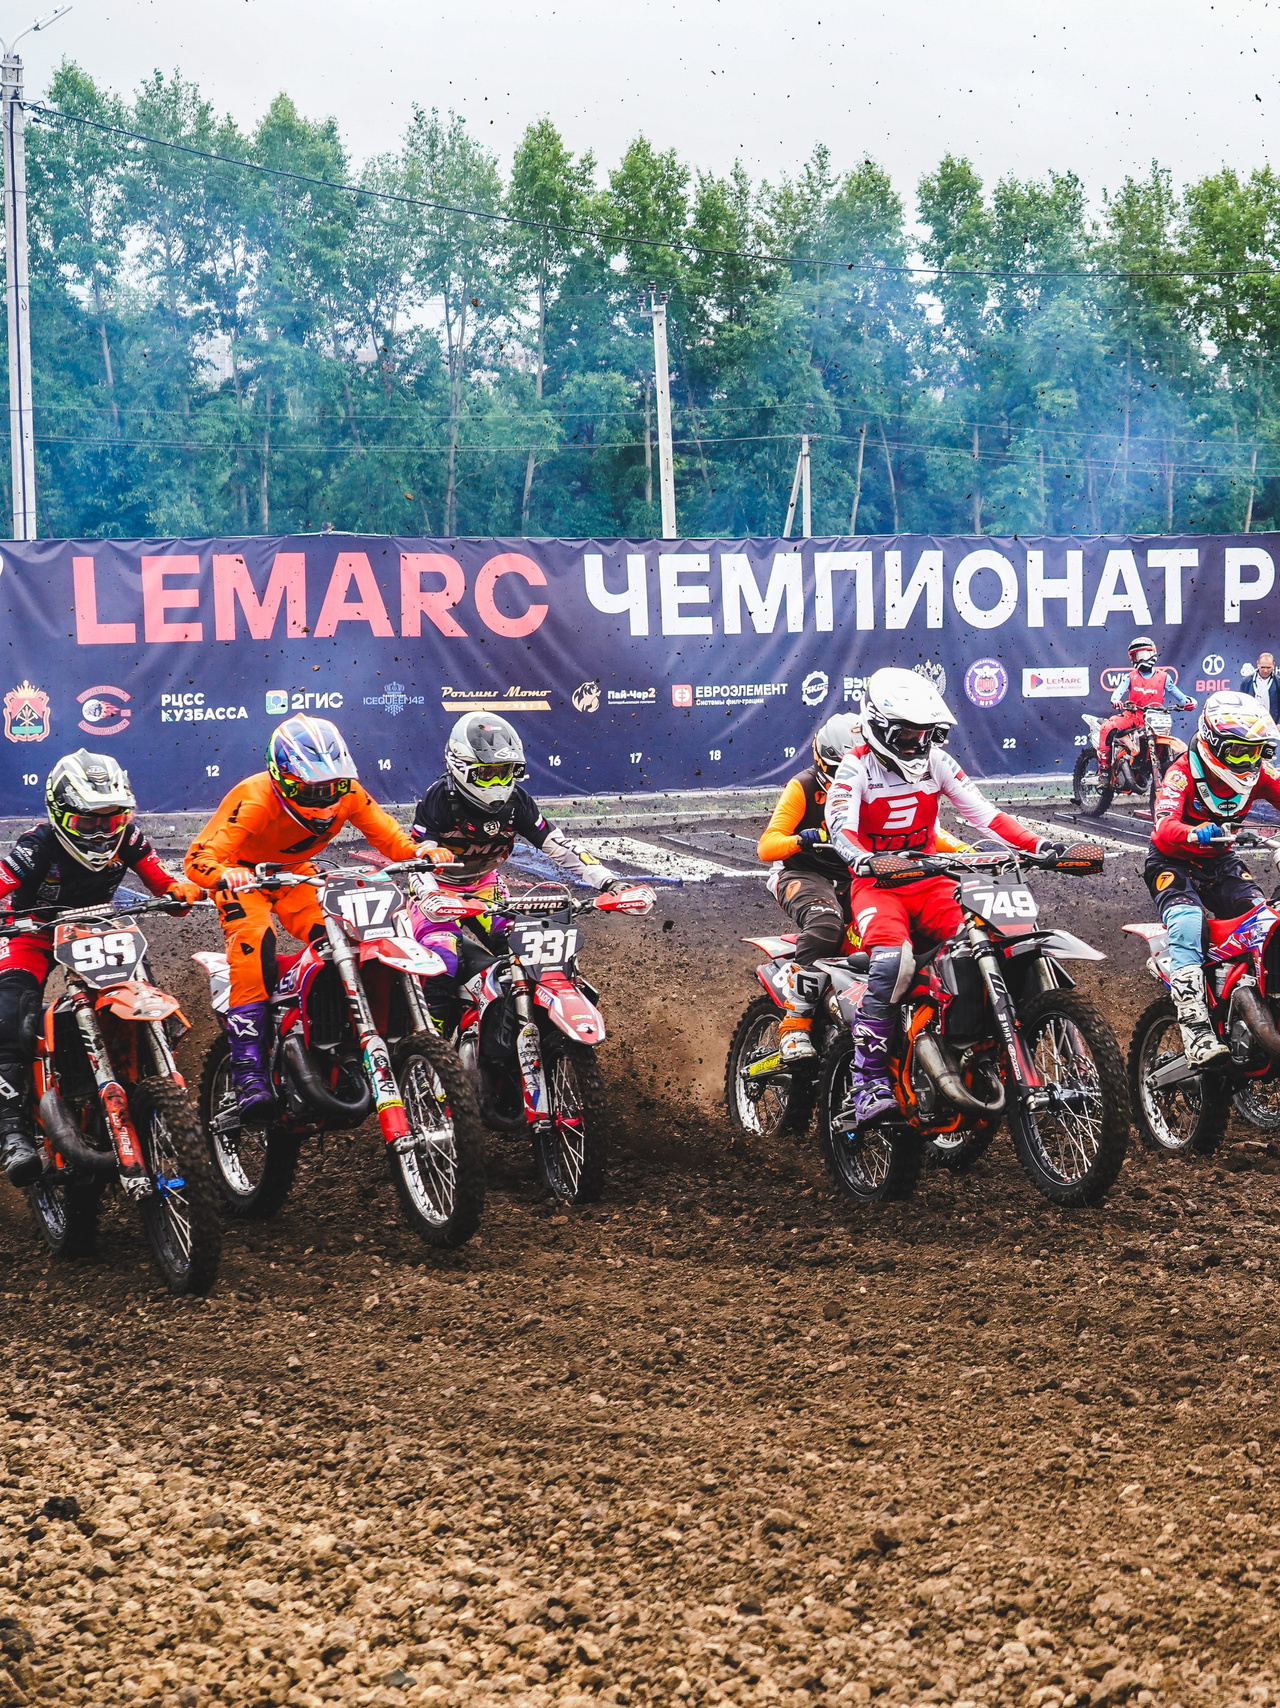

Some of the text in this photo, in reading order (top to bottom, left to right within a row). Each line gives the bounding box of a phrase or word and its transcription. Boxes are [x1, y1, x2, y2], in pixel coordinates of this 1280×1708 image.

[73, 552, 548, 645] LEMARC
[584, 548, 1199, 636] ЧЕМПИОНАТ
[1046, 677, 1082, 685] LEMARC
[1195, 679, 1230, 692] BAIC
[607, 687, 656, 700] Пай-Чер2
[695, 683, 788, 698] ЕВРОЭЛЕМЕНТ
[844, 690, 863, 702] ГО
[161, 693, 205, 708] РЦСС
[291, 692, 343, 709] 2ГИС
[363, 696, 425, 705] ICEQUEEN42
[695, 698, 725, 706] Системы
[161, 707, 248, 723] КУЗБАССА
[1003, 738, 1016, 749] 22
[1074, 735, 1088, 746] 23
[629, 753, 642, 765] 17
[709, 750, 722, 761] 18
[784, 747, 796, 758] 19
[377, 759, 391, 771] 14
[548, 755, 562, 767] 16
[206, 765, 220, 777] 12
[22, 773, 39, 786] 10
[337, 890, 396, 930] 117
[972, 890, 1038, 919] 749
[71, 932, 137, 972] 99
[519, 929, 578, 966] 331
[837, 980, 869, 1008] 74
